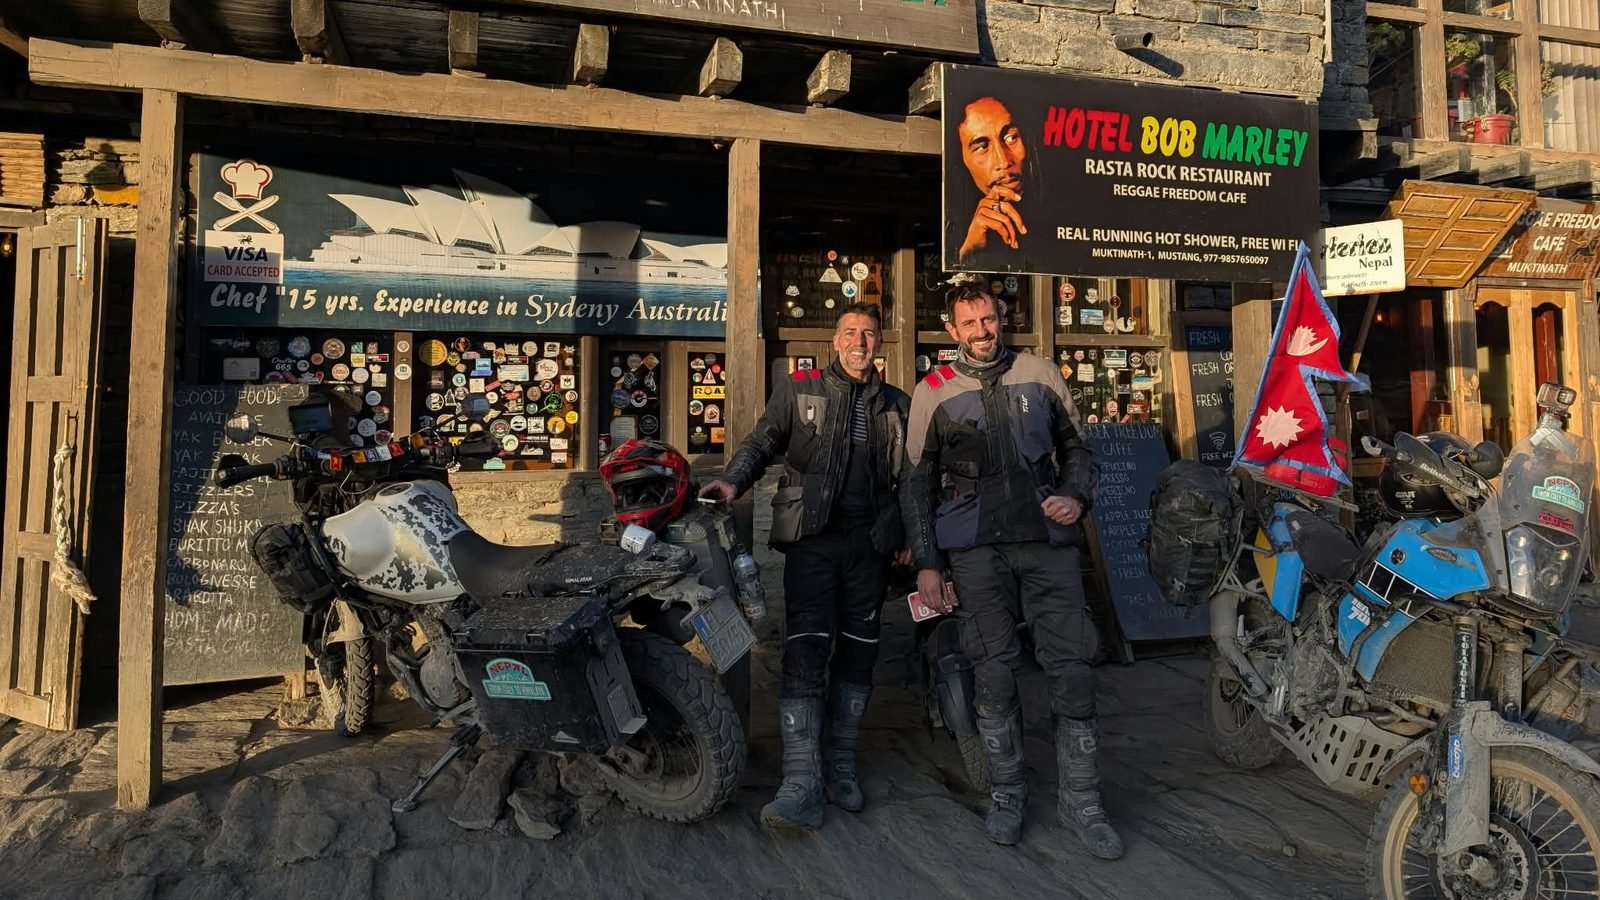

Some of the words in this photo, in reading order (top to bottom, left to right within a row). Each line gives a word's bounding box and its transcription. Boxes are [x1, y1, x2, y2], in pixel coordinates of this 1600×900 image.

[652, 0, 778, 19] UKTINATH
[1043, 105, 1133, 153] HOTEL
[1140, 115, 1197, 158] BOB
[1202, 122, 1308, 167] MARLEY
[1085, 158, 1133, 177] RASTA
[1137, 162, 1177, 180] ROCK
[1180, 165, 1272, 187] RESTAURANT
[1113, 184, 1160, 198] REGGAE
[1162, 187, 1217, 202] FREEDOM
[1219, 191, 1247, 204] CAFE
[1553, 211, 1600, 230] FREEDO
[1057, 226, 1090, 241] REAL
[1093, 228, 1153, 244] RUNNING
[1155, 231, 1181, 246] HOT
[1183, 233, 1239, 250] SHOWER,
[1241, 236, 1270, 250] FREE
[1271, 238, 1286, 251] WI
[1533, 232, 1568, 252] CAFÉ
[221, 246, 269, 262] VISA
[1092, 248, 1155, 260] MUKTINATH-1,
[1158, 251, 1202, 263] MUSTANG,
[1203, 253, 1269, 265] 977-9857650097
[208, 265, 233, 276] CARD
[235, 266, 280, 278] ACCEPTED
[1359, 256, 1393, 271] Nepal
[1507, 262, 1568, 274] MUKTINATH
[210, 283, 268, 313] Chef
[325, 293, 364, 315] yrs.
[374, 288, 488, 317] Experience
[496, 295, 517, 315] in
[524, 294, 619, 326] Sydeny
[625, 298, 727, 322] Australi
[1189, 331, 1220, 345] FRESH
[1191, 362, 1220, 376] FRESH
[174, 390, 225, 407] GOOD
[695, 387, 726, 395] ROA
[1196, 393, 1223, 407] FRESH
[174, 430, 201, 444] YAK
[173, 449, 202, 463] YAK
[211, 451, 263, 464] SAK
[1202, 452, 1220, 461] FREE
[172, 518, 209, 535] SHAK
